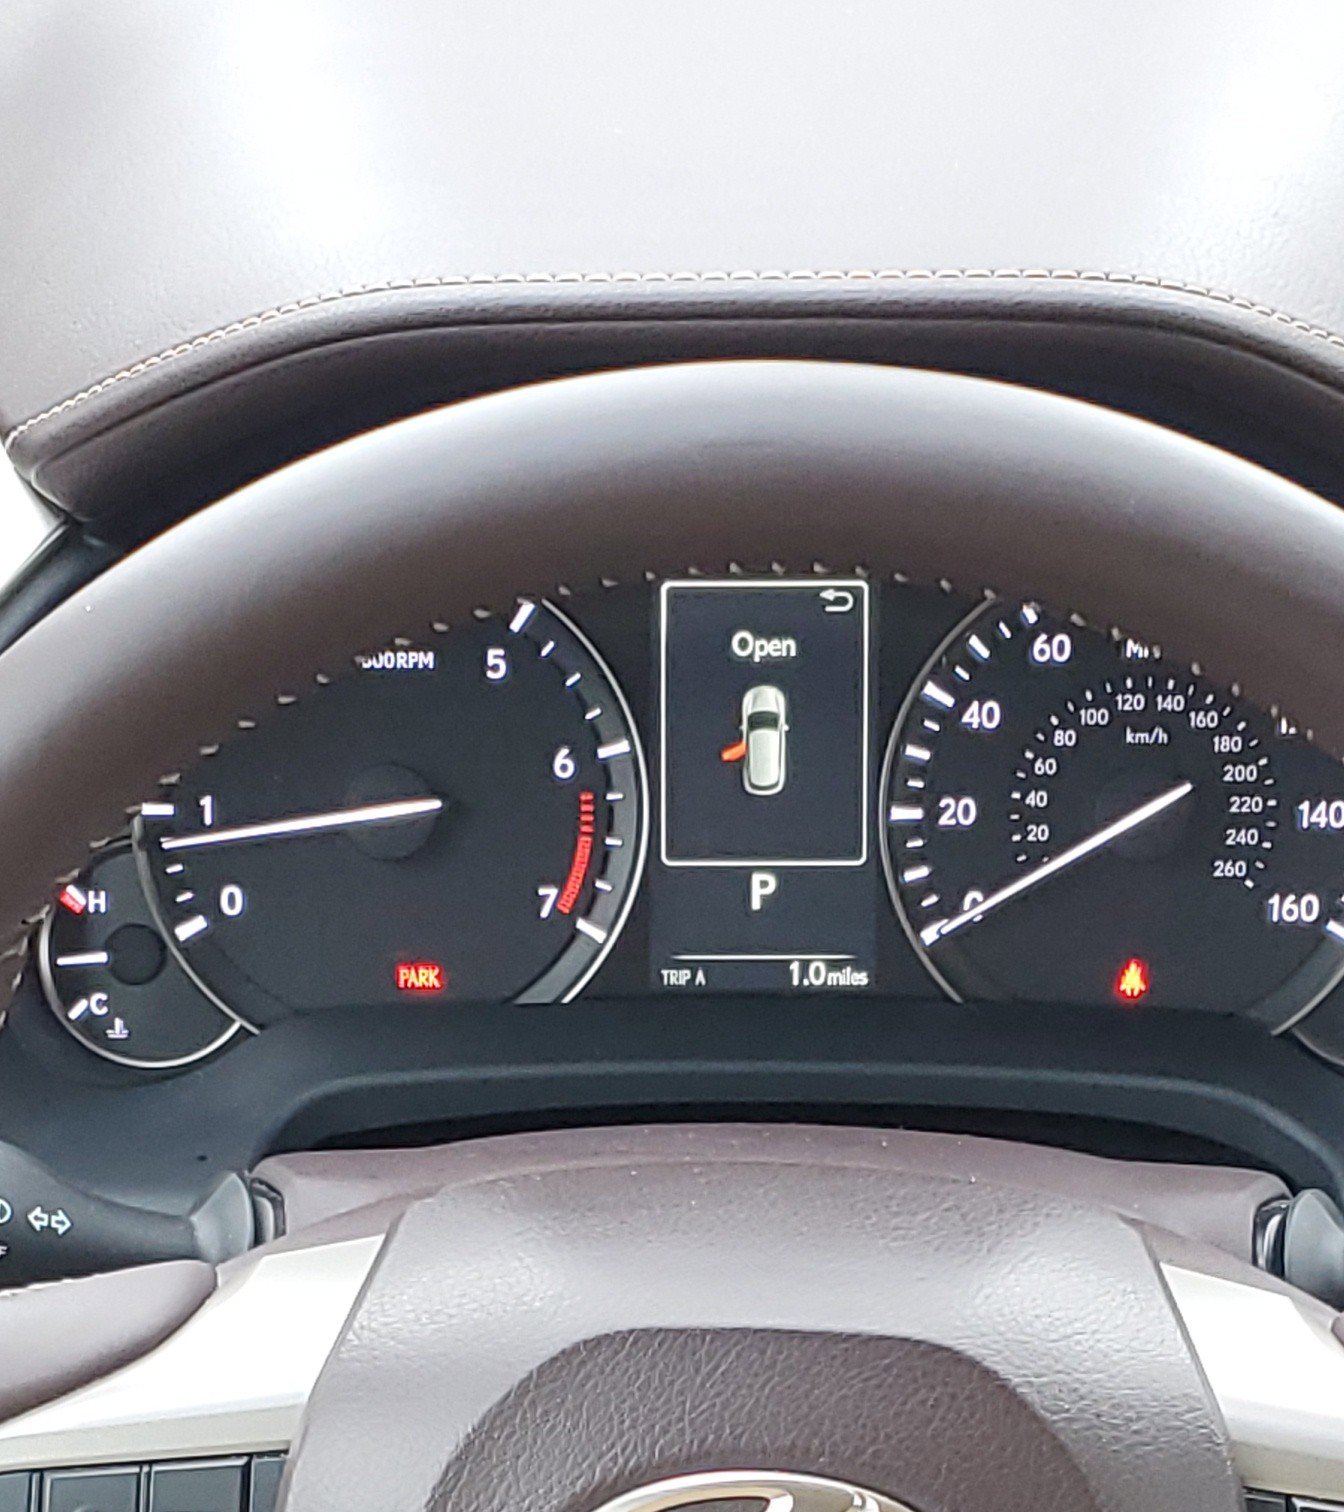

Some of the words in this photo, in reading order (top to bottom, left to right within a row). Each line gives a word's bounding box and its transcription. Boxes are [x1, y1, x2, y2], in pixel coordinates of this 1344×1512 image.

[731, 630, 797, 662] Open
[1032, 635, 1072, 663] 60
[486, 648, 506, 680] 5
[1115, 693, 1145, 711] 120
[1156, 694, 1186, 712] 140
[962, 701, 1001, 730] 40
[1079, 708, 1109, 727] 100
[1189, 711, 1218, 729] 160
[1054, 729, 1076, 746] 80
[1125, 726, 1169, 744] km/h
[1213, 736, 1243, 753] 180
[553, 751, 575, 779] 6
[1034, 758, 1057, 776] 60
[1223, 765, 1258, 783] 200
[1026, 791, 1048, 809] 40
[1229, 796, 1264, 814] 220
[200, 795, 214, 826] 1
[938, 798, 976, 826] 20
[1027, 824, 1049, 843] 20
[1224, 828, 1259, 847] 240
[1213, 860, 1247, 880] 260
[220, 885, 242, 915] 0
[750, 872, 777, 911] P
[88, 891, 106, 913] H
[537, 887, 558, 919] 7
[1269, 894, 1320, 922] 160
[399, 967, 441, 988] PARK
[661, 969, 691, 986] TRIP
[694, 969, 706, 986] A
[91, 993, 108, 1016] C
